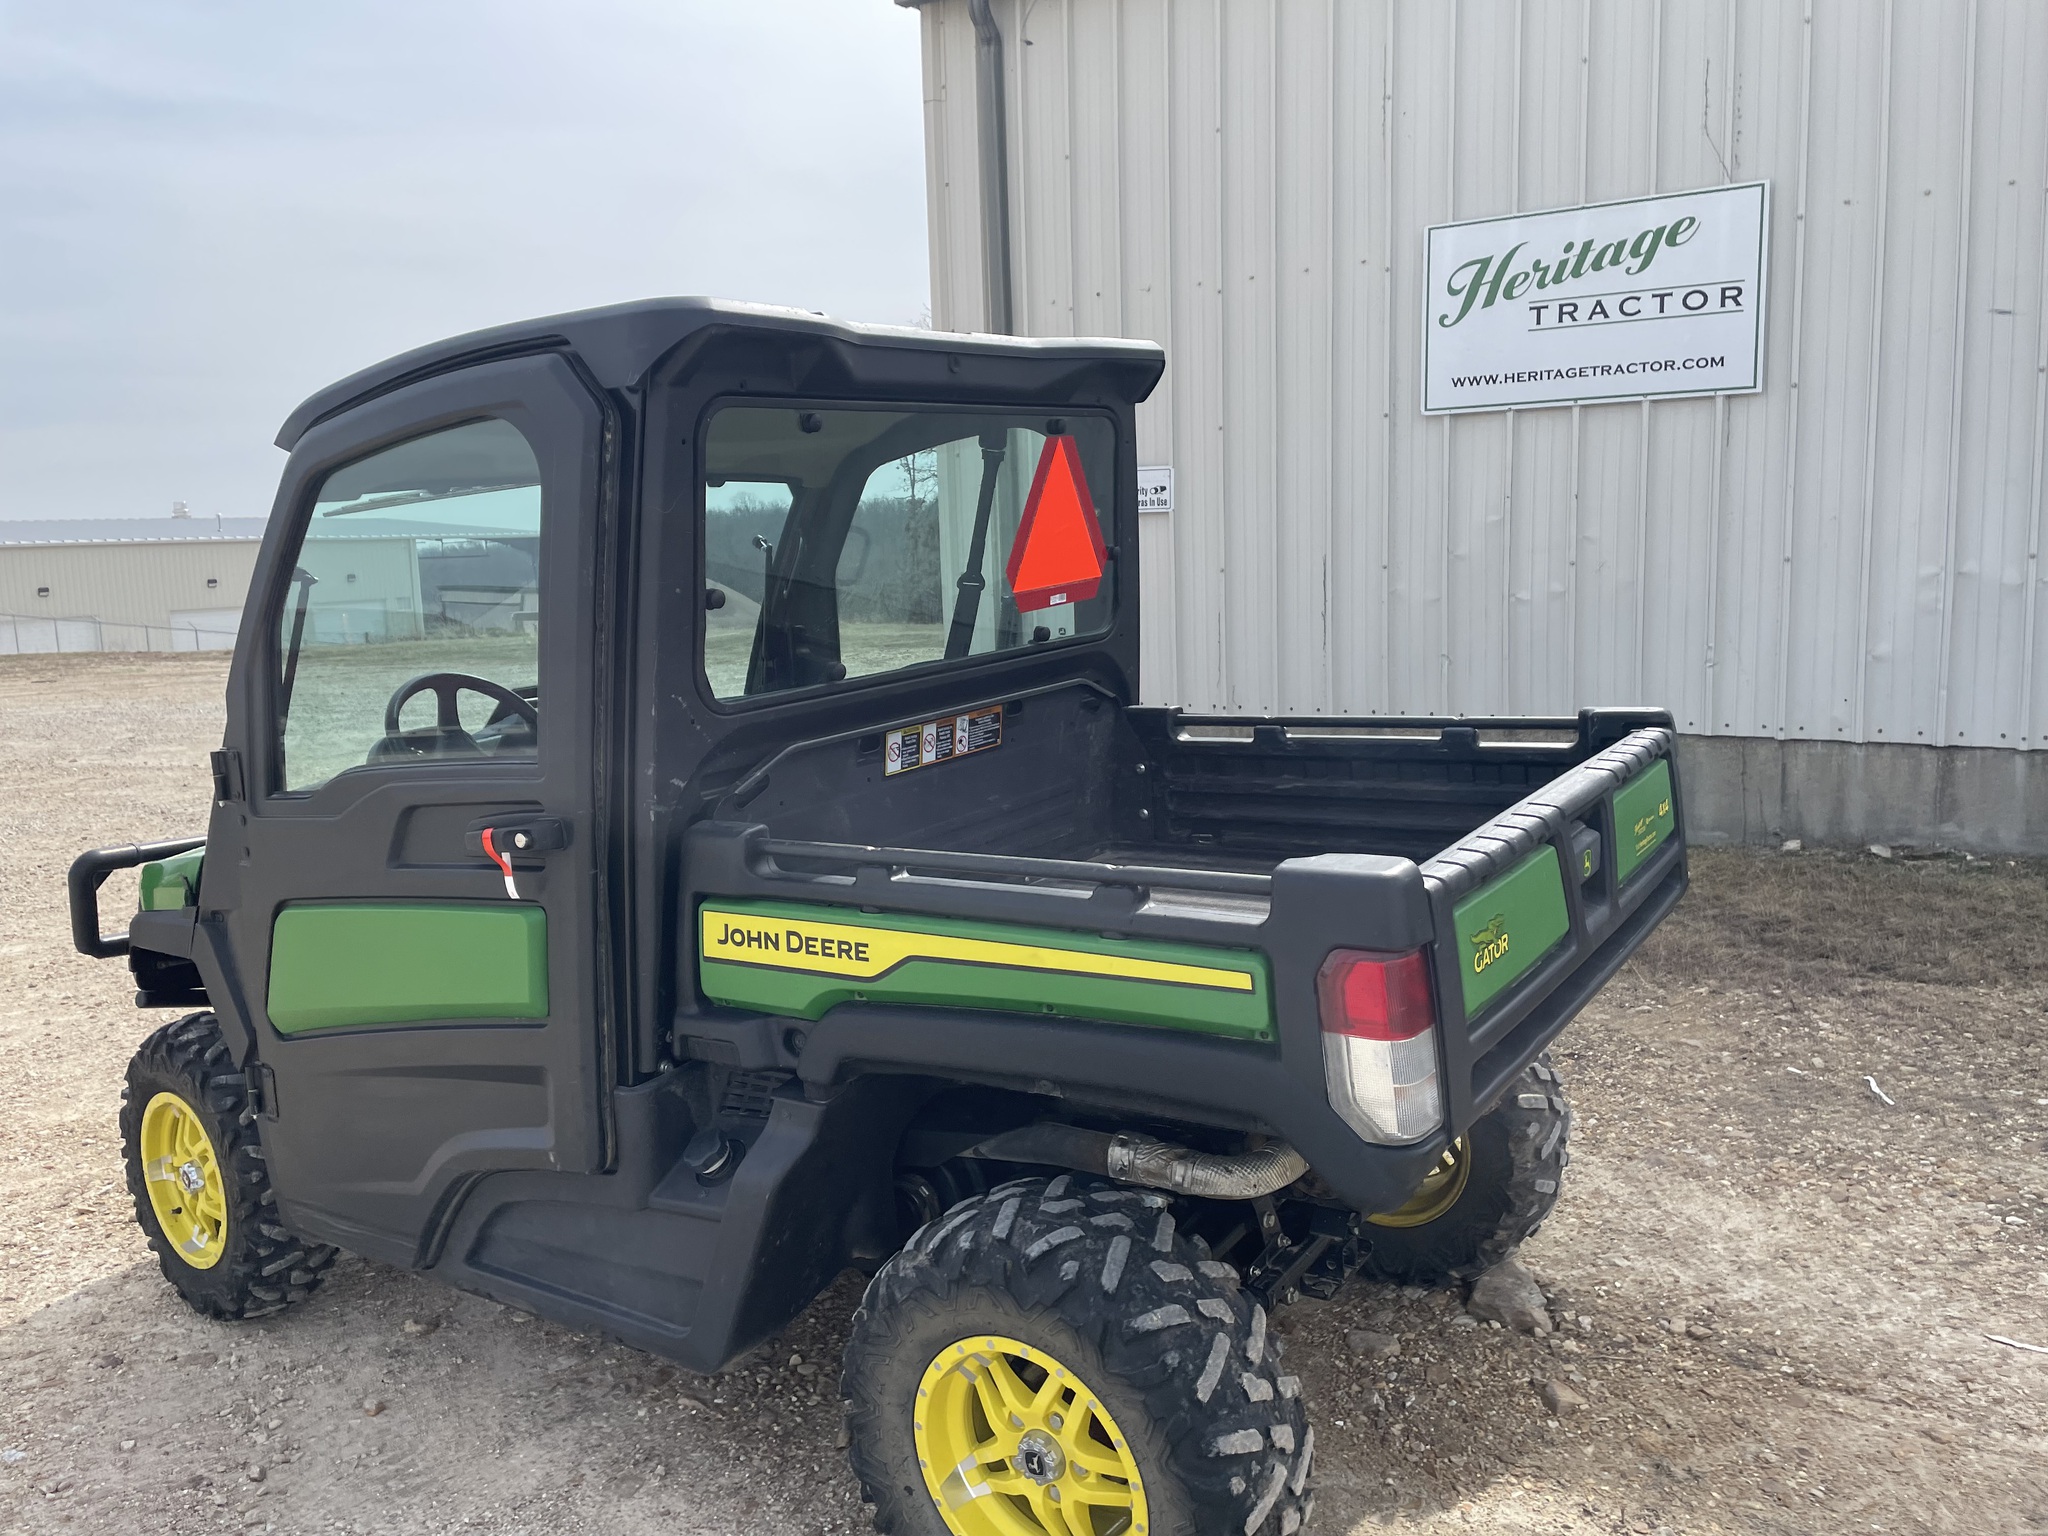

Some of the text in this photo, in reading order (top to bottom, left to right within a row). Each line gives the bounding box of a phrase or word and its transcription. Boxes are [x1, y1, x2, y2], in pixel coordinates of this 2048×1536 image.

[1438, 216, 1701, 328] Heritage
[1529, 286, 1744, 326] TRACTOR
[1451, 356, 1725, 387] WWW.HERITAGETRACTOR.COM
[1157, 497, 1168, 507] Use
[717, 923, 870, 962] JOHN DEERE
[1474, 933, 1509, 973] GATOR
